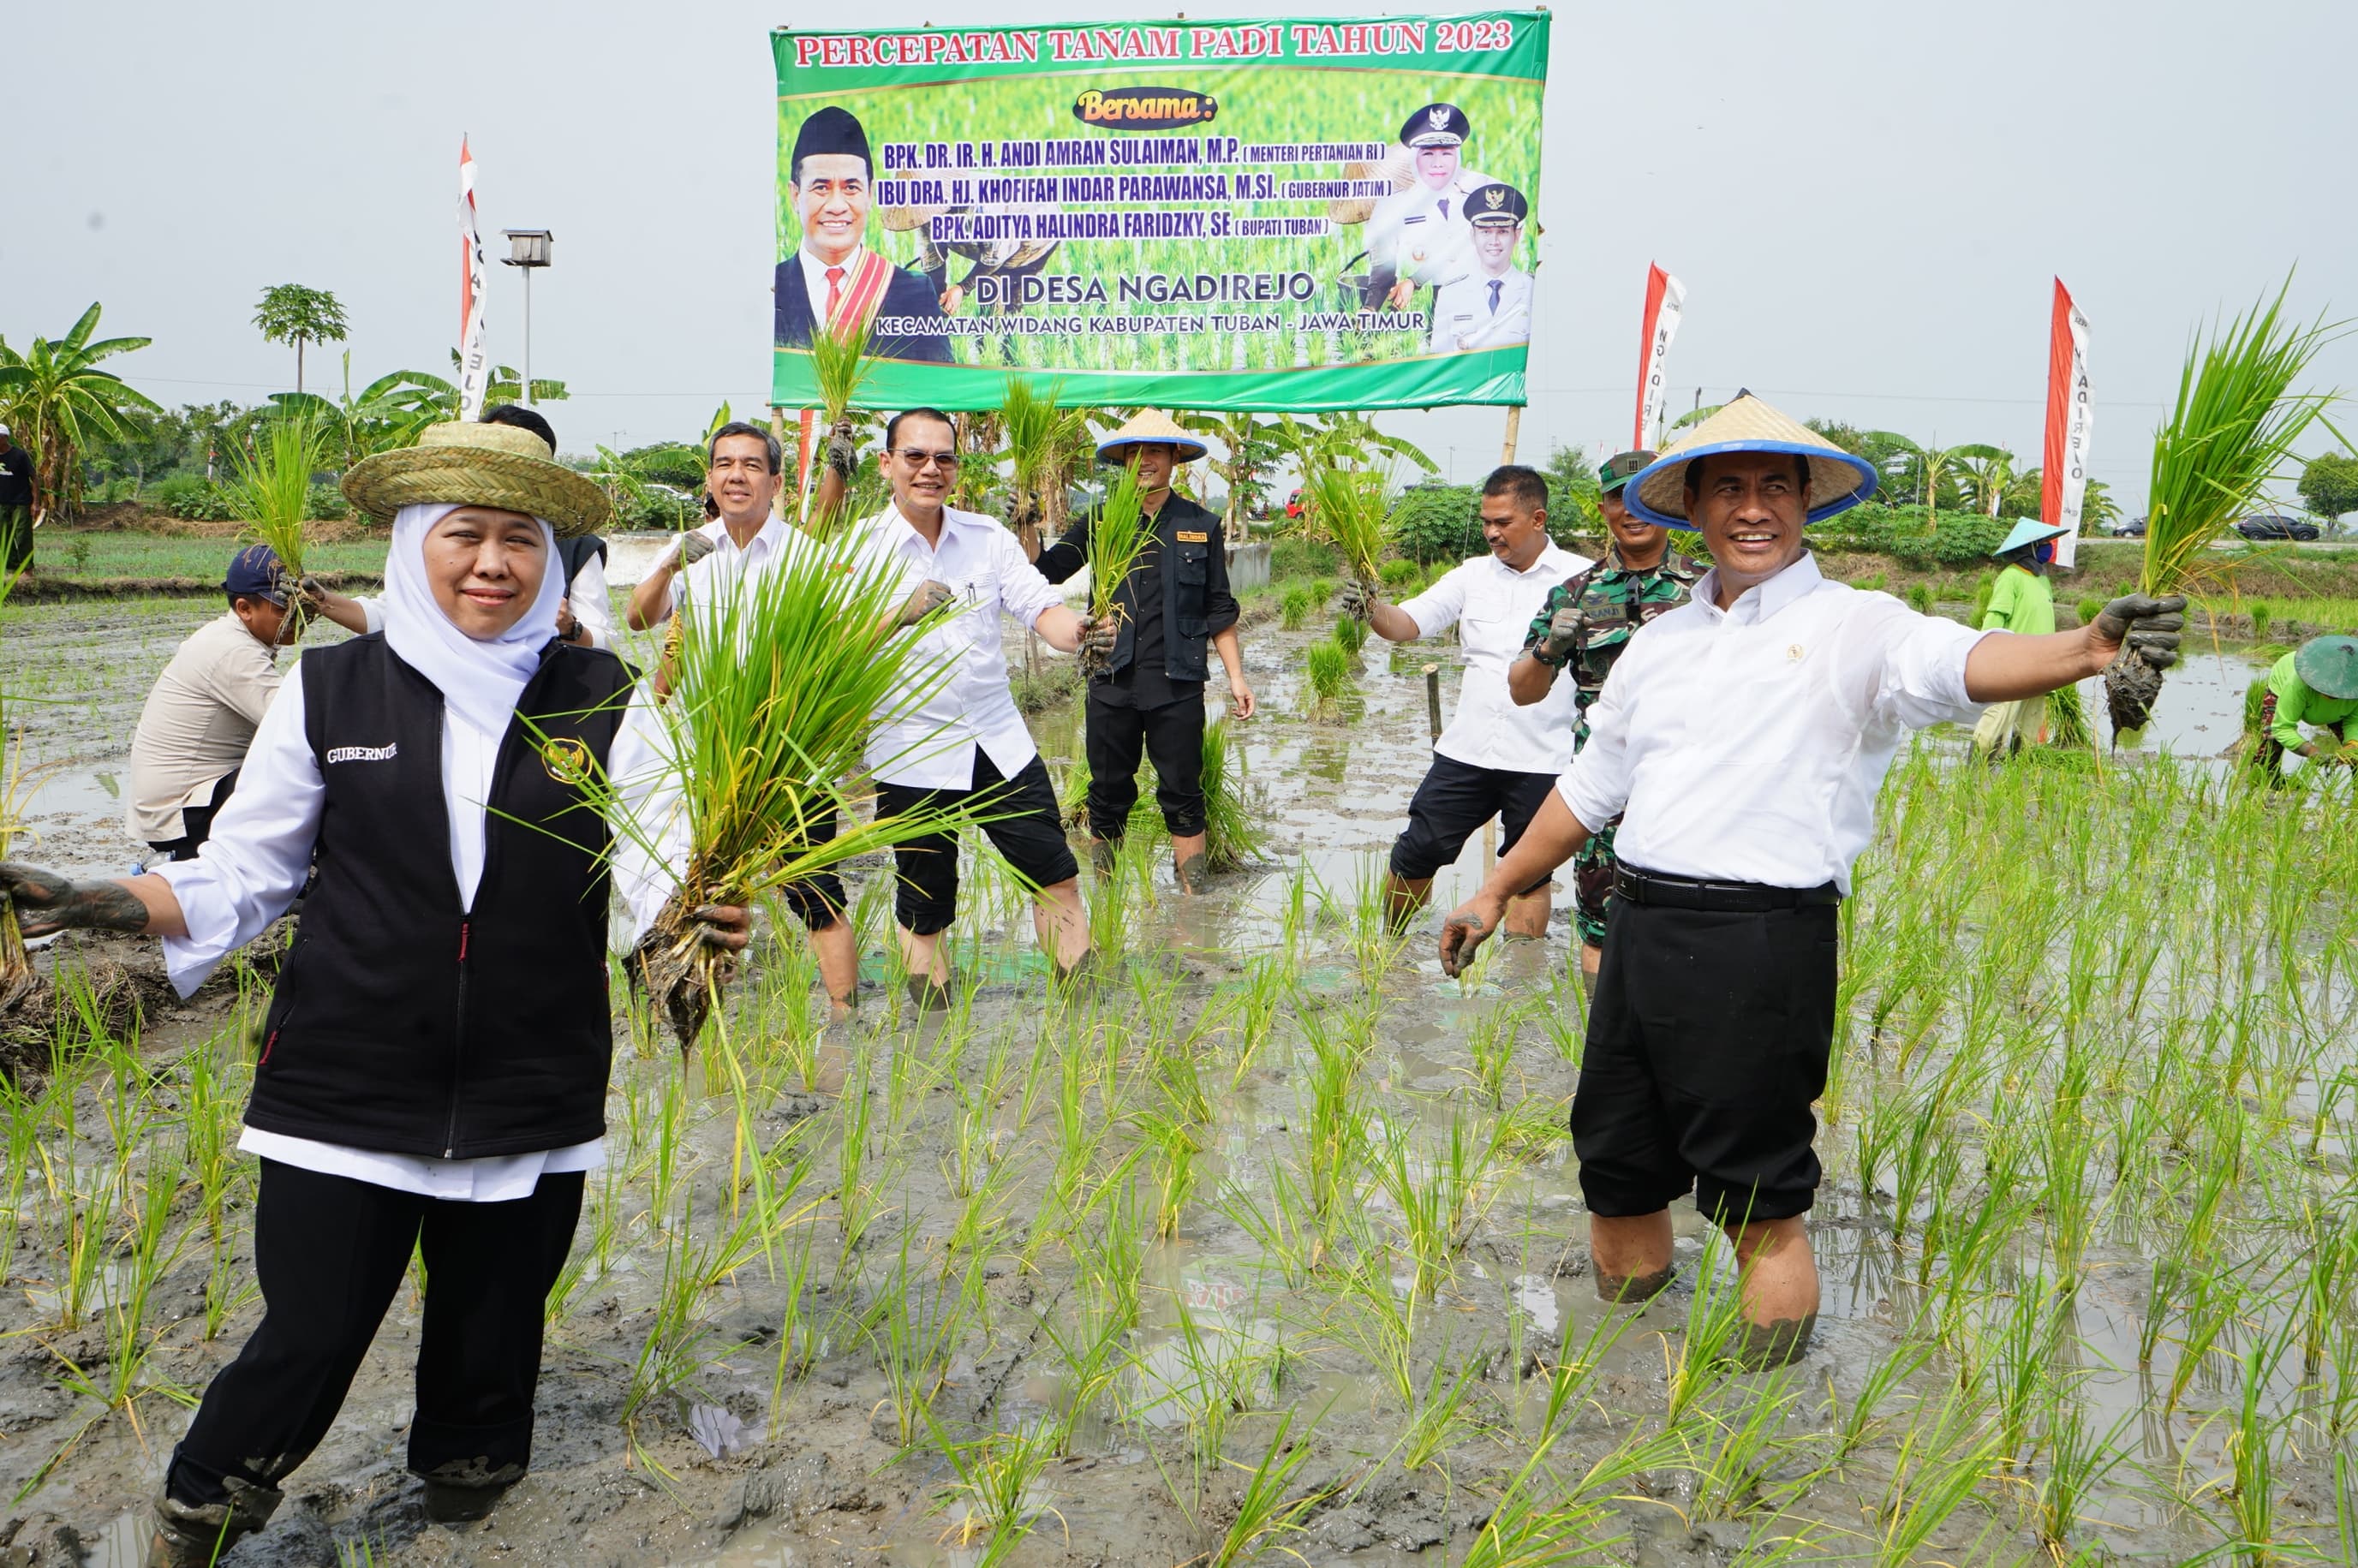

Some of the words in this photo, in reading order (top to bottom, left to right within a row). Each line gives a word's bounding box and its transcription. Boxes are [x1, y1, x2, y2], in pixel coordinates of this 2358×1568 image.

[796, 32, 1037, 66] PERCEPATAN
[1049, 29, 1178, 61] TANAM
[1191, 27, 1282, 57] PADI
[1292, 24, 1425, 55] TAHUN
[1436, 22, 1512, 51] 2023
[885, 145, 921, 169] BPK.
[926, 144, 952, 168] DR.
[957, 143, 976, 168] IR.
[982, 143, 996, 167] H.
[1000, 142, 1041, 167] ANDI
[1045, 140, 1105, 166] AMRAN
[1110, 139, 1202, 166] SULAIMAN,
[1207, 138, 1239, 163] M.P.
[1302, 145, 1363, 161] PERTANIAN
[878, 181, 905, 206] IBU
[910, 181, 948, 205] DRA.
[952, 180, 974, 205] HJ.
[979, 178, 1058, 204] KHOFIFAH
[1062, 177, 1114, 202] INDAR
[1119, 176, 1231, 202] PARAWANSA,
[1236, 174, 1277, 200] M.SI.
[933, 216, 969, 240] BPK.
[973, 214, 1029, 239] ADITYA
[1036, 213, 1119, 239] HALINDRA
[1124, 212, 1206, 238] FARIDZKY,
[1210, 212, 1231, 235] SE
[977, 276, 1011, 304] DI
[1024, 276, 1107, 303] DESA
[1119, 273, 1315, 302] NGADIREJO
[877, 317, 994, 335] KECAMATAN
[1000, 317, 1082, 334] WIDANG
[1089, 315, 1204, 333] KABUPATEN
[1210, 315, 1280, 332] TUBAN
[1299, 313, 1352, 331] JAWA
[1357, 313, 1425, 330] TIMUR
